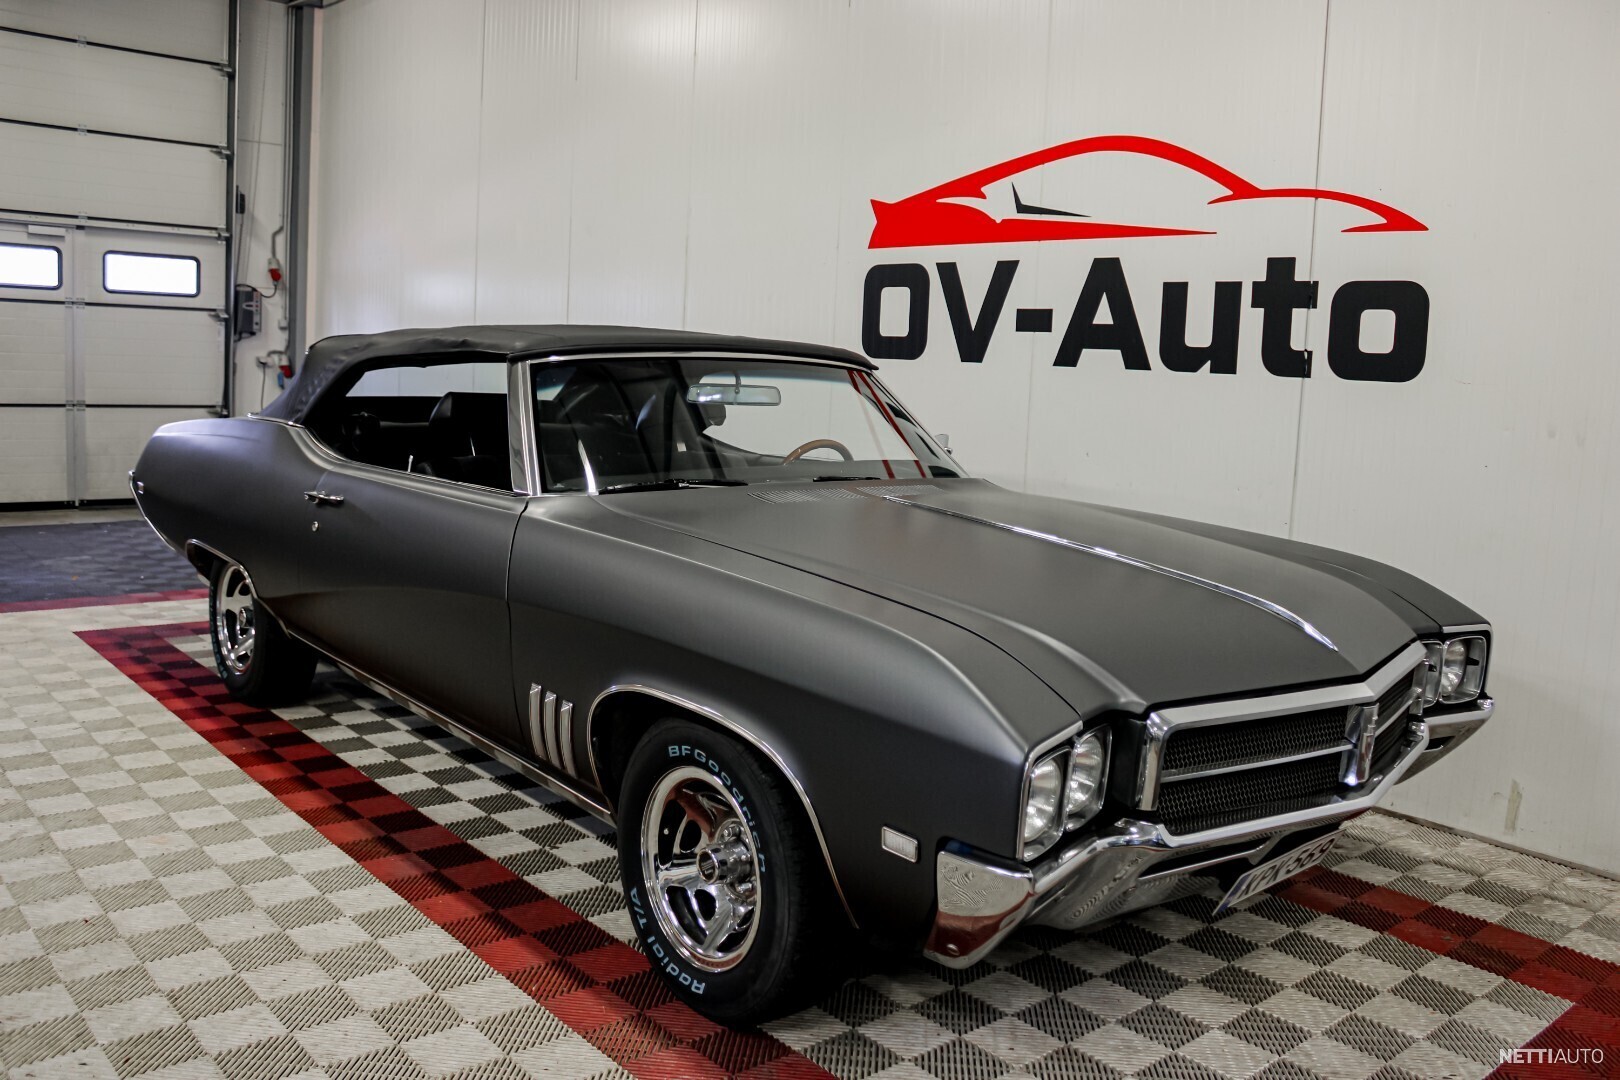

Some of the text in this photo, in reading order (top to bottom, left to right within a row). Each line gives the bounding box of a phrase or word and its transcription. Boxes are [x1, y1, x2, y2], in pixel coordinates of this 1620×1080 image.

[862, 256, 1431, 383] OV-Auto
[668, 745, 766, 874] BFGoodrich
[630, 886, 706, 995] Radial T/A
